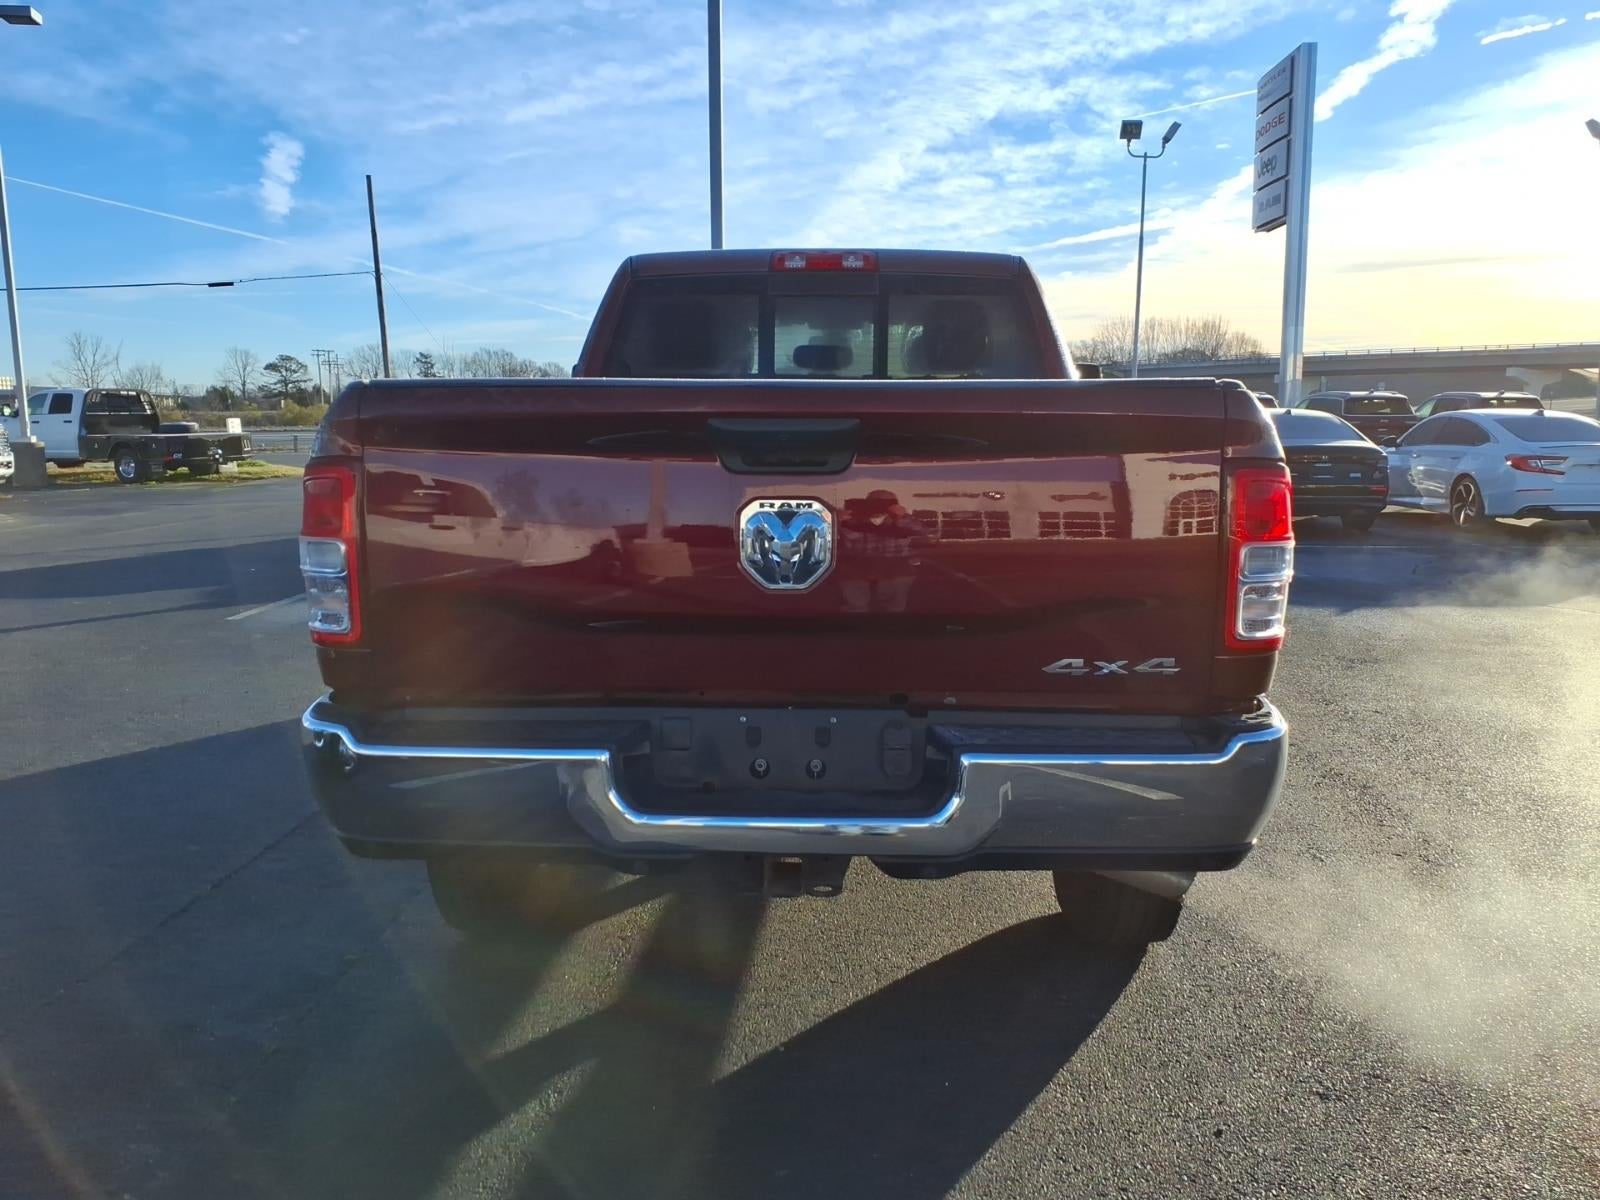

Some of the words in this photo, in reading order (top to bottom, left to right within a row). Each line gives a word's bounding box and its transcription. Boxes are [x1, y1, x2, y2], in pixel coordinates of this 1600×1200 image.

[1256, 112, 1286, 141] DODGE
[1257, 154, 1277, 179] Jeep
[1041, 657, 1182, 676] 4x4
